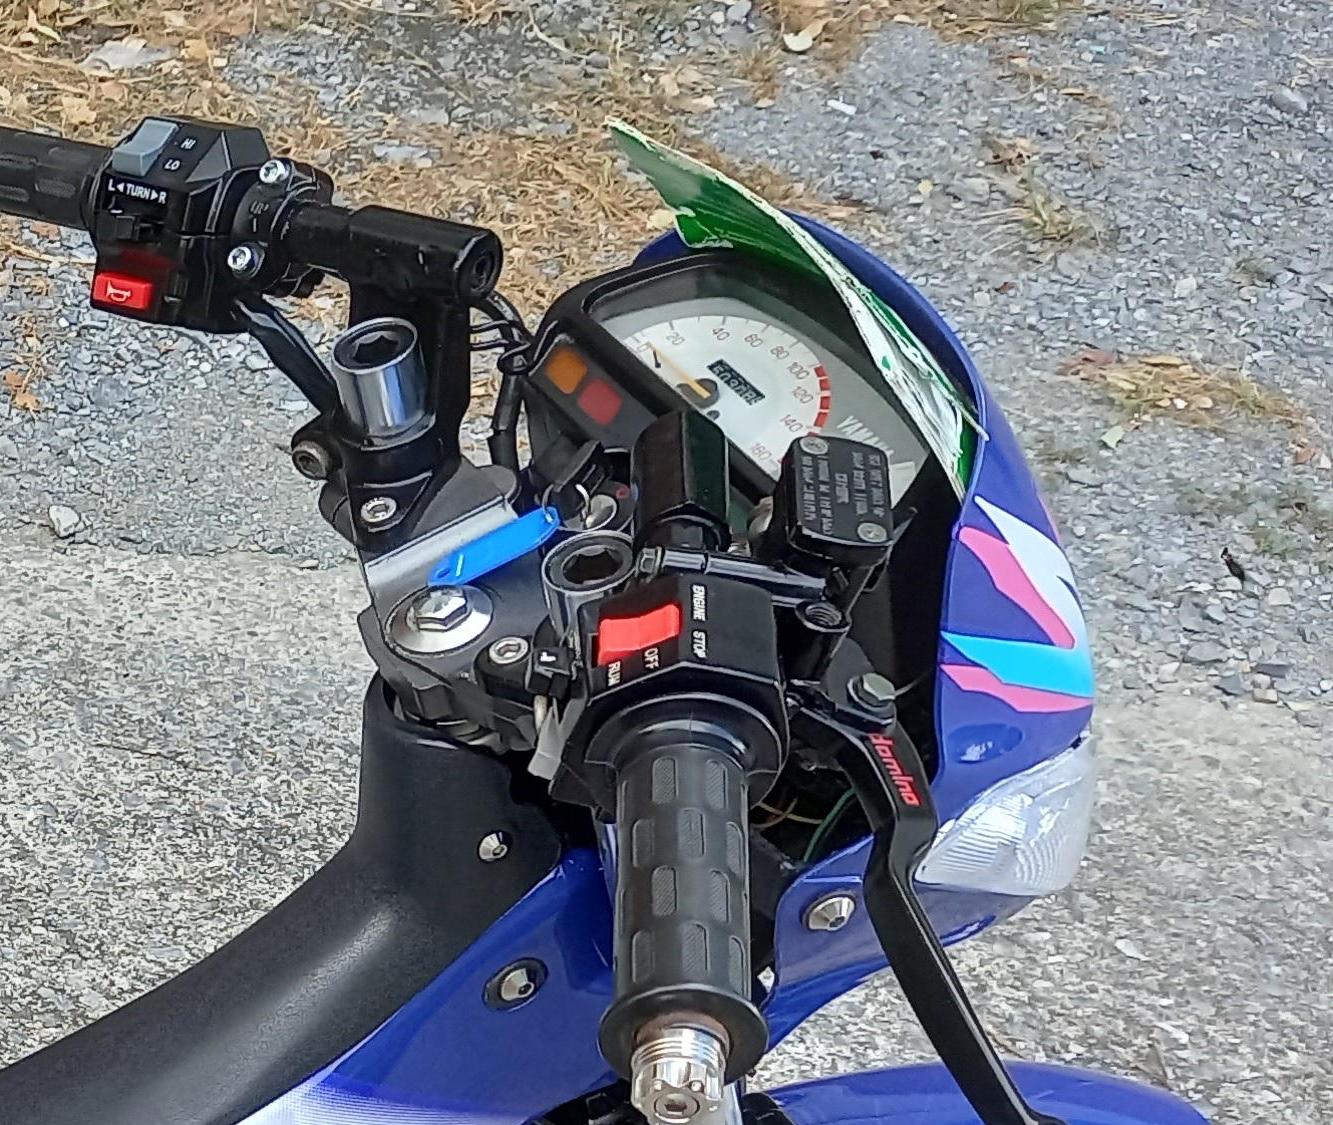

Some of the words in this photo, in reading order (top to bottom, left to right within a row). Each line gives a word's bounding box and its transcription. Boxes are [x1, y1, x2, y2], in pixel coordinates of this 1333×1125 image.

[181, 138, 197, 150] HI
[164, 159, 181, 171] LO
[126, 183, 151, 200] TURN
[666, 332, 685, 345] 20
[712, 327, 729, 341] 40
[744, 333, 763, 348] 60
[770, 345, 790, 360] 80
[786, 361, 810, 381] 100
[791, 386, 814, 405] 120
[779, 414, 804, 433] 140
[749, 443, 772, 462] 160
[692, 584, 707, 622] ENGINE
[692, 630, 707, 659] STOP
[644, 648, 659, 669] OFF
[608, 661, 621, 687] RUN
[868, 733, 920, 807] domino
